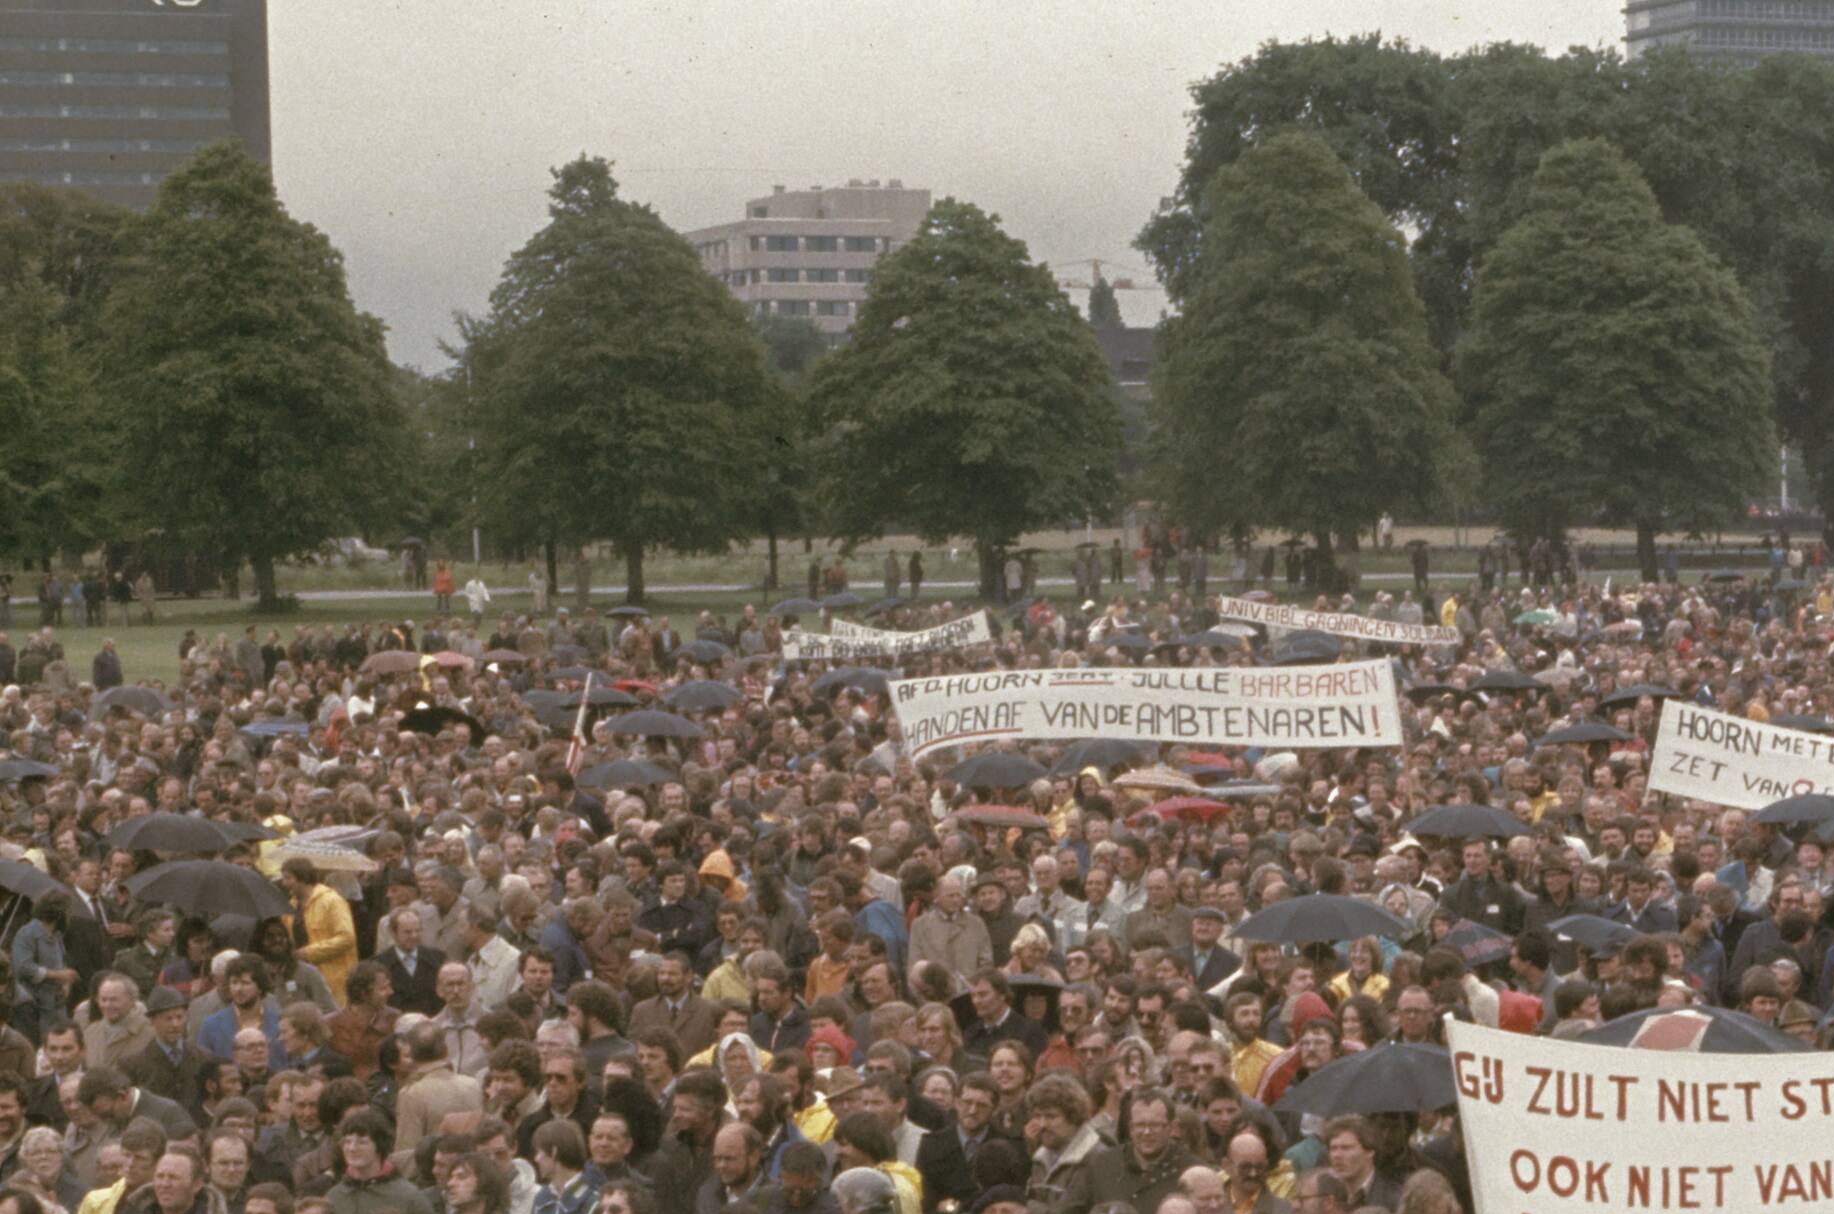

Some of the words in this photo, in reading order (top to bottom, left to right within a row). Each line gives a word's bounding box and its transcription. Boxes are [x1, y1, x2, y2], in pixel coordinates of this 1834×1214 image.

[995, 702, 1026, 729] AF
[1039, 701, 1099, 730] VAN
[1104, 704, 1132, 726] DE
[1678, 709, 1762, 757] HOORN
[1771, 735, 1819, 759] MET
[1670, 751, 1728, 782] ZET
[1743, 774, 1790, 798] VAN
[1525, 1066, 1638, 1121] ZULT
[1658, 1079, 1761, 1122] NIET
[1510, 1148, 1611, 1204] OOK
[1628, 1164, 1733, 1209] NIET
[1754, 1160, 1832, 1205] VAN
